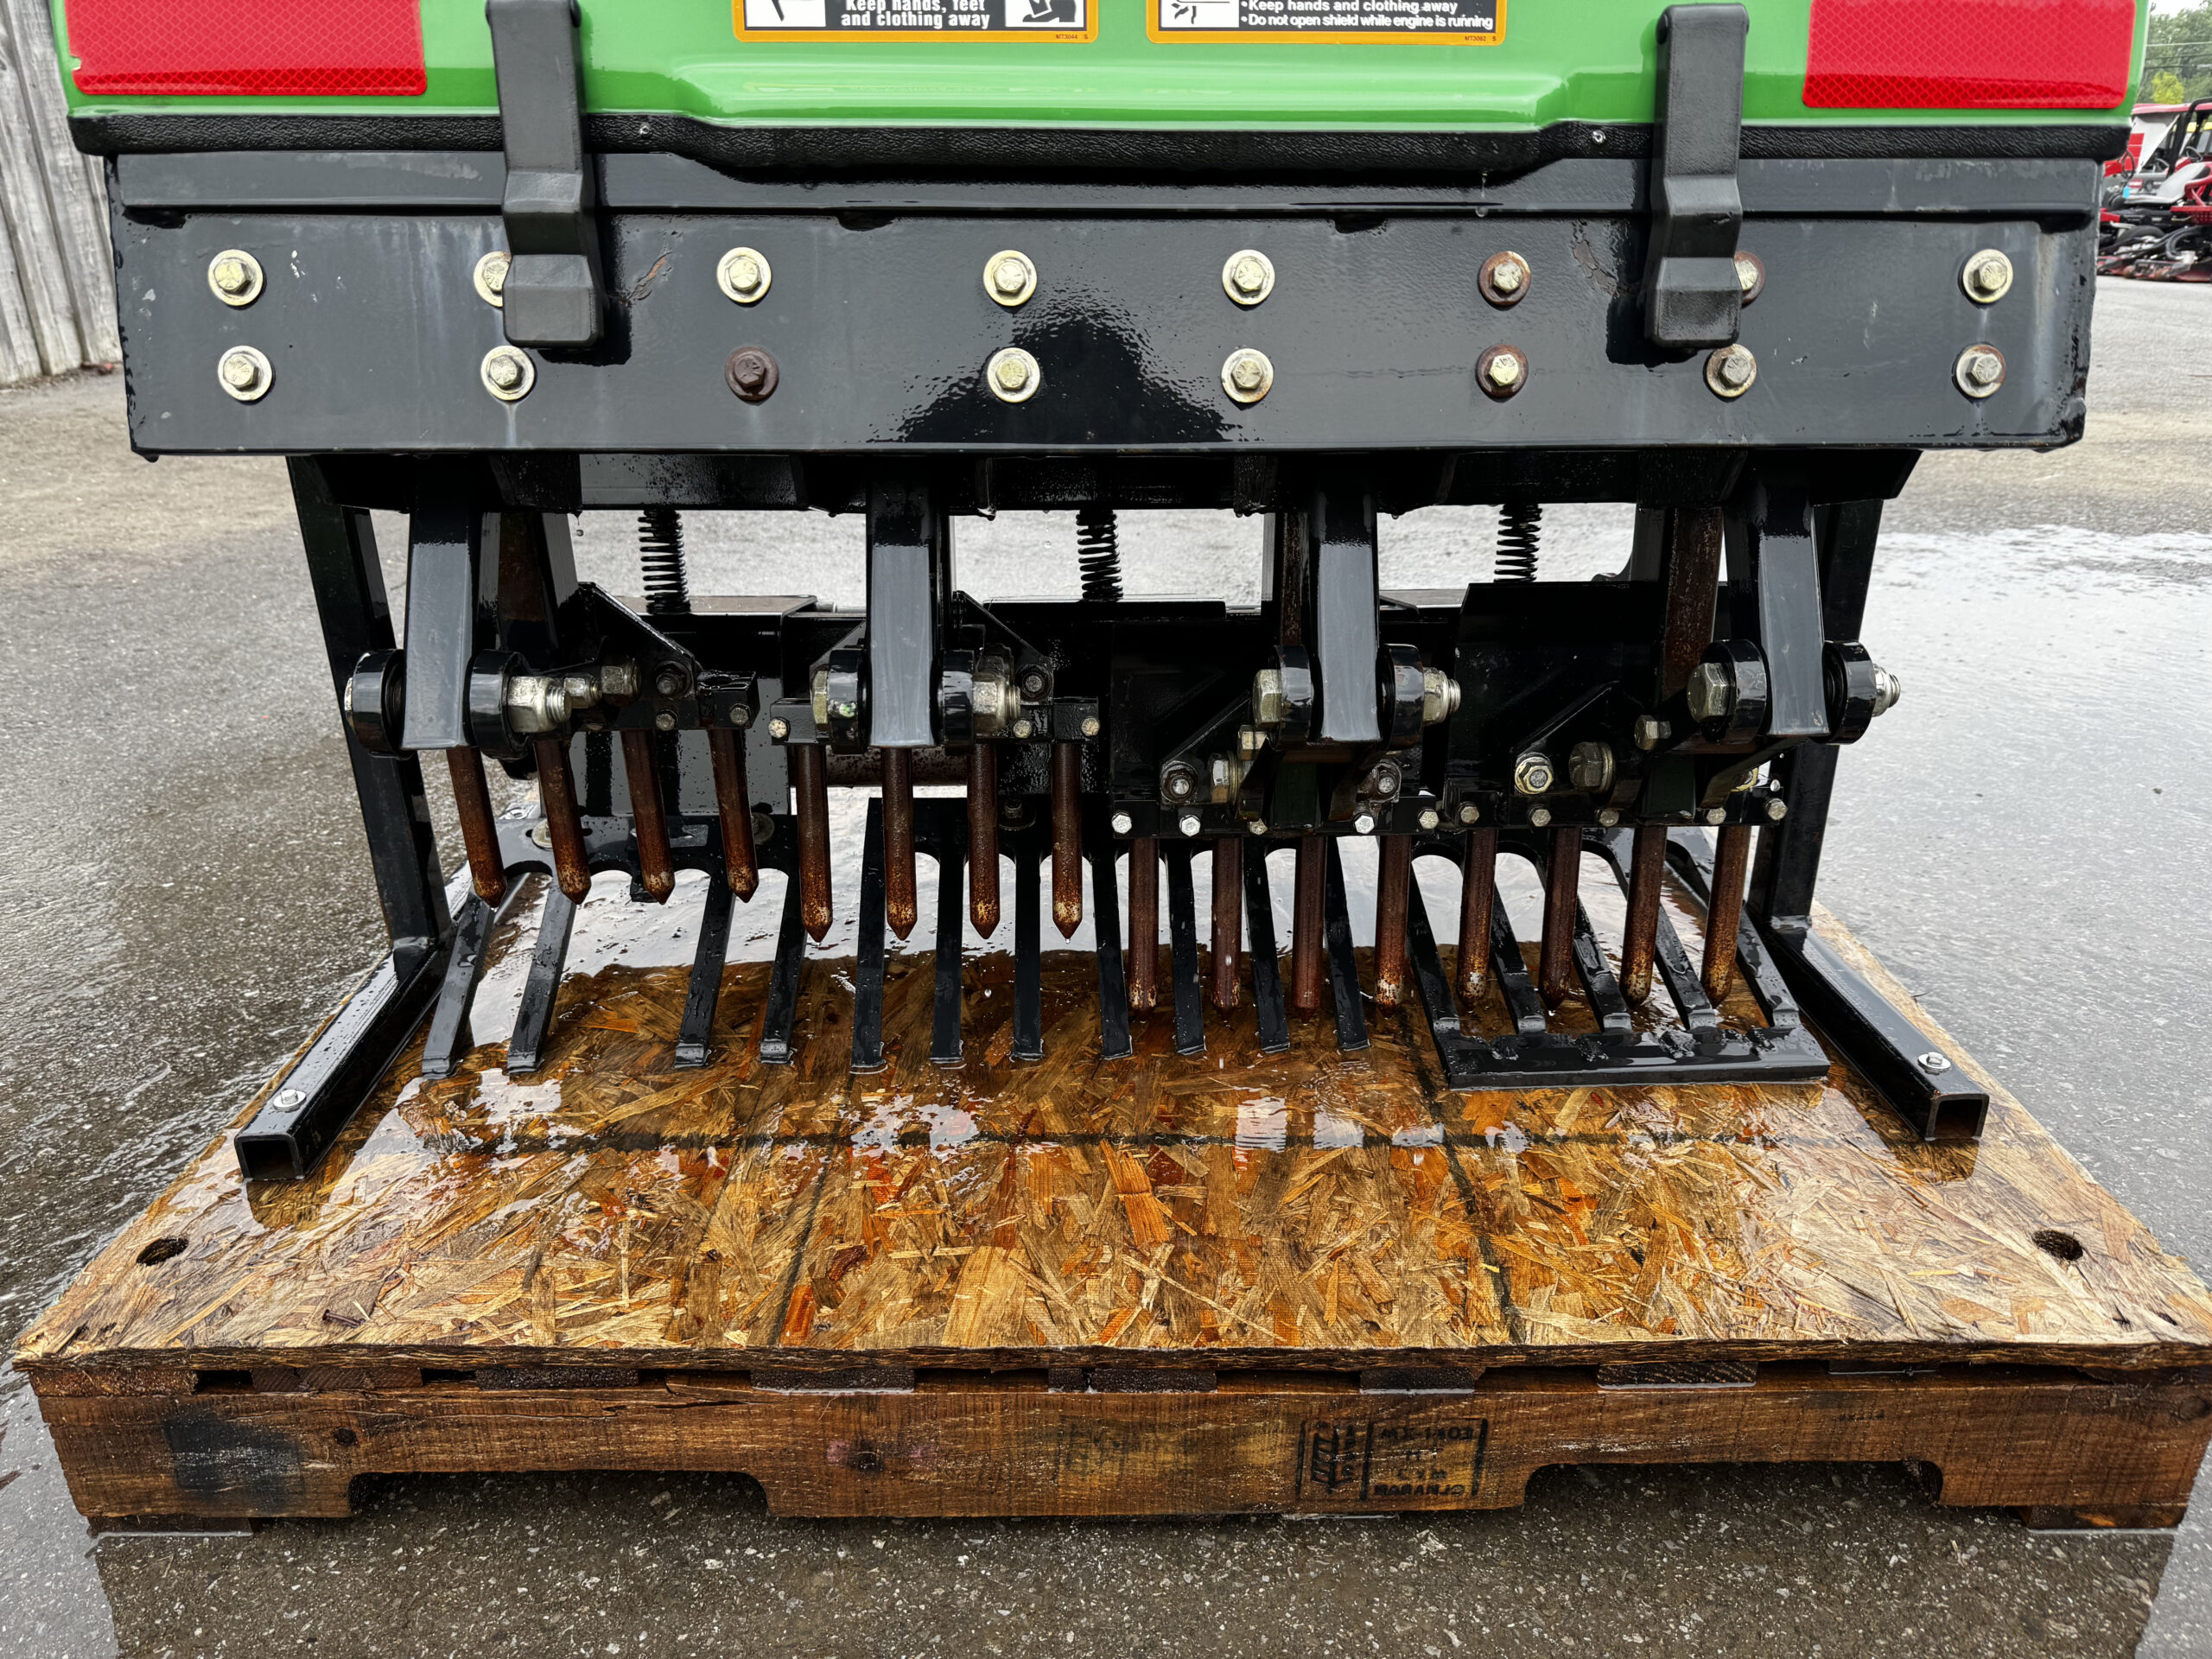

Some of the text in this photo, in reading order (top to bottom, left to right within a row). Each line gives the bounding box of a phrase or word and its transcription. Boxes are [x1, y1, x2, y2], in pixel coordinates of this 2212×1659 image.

[846, 0, 886, 14] Keep
[892, 0, 947, 13] hands,
[1249, 0, 1459, 15] Keep hands and clothing away
[841, 11, 990, 29] and clothing away
[1249, 14, 1493, 30] Do not open shield while engine is running
